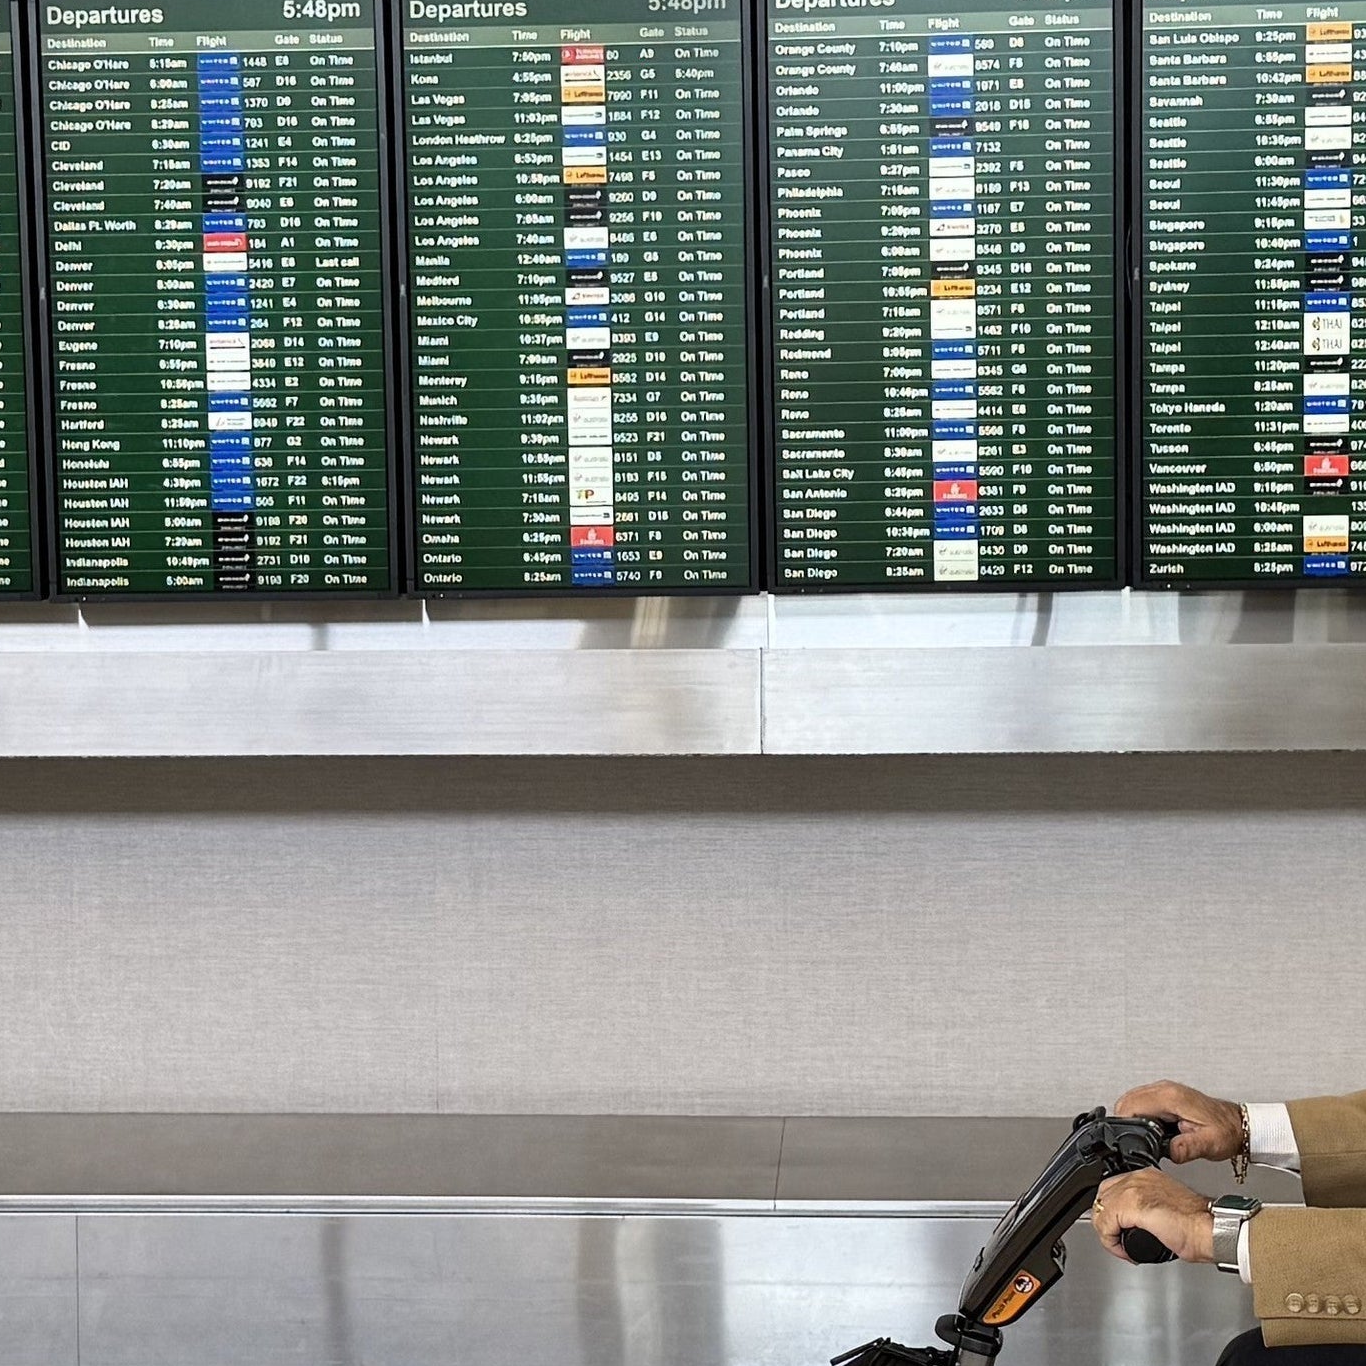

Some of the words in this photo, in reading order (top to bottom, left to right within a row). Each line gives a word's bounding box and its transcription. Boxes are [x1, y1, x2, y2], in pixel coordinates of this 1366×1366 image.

[46, 6, 163, 28] Departures
[283, 0, 360, 21] 5:48pm
[409, 0, 527, 22] Departures
[1149, 11, 1211, 22] Destination
[1256, 8, 1282, 19] Time
[1306, 7, 1338, 19] Flight
[775, 21, 835, 32] Destination
[879, 19, 905, 30] Time
[928, 17, 959, 30] Flight
[1008, 15, 1034, 26] Gate
[1044, 14, 1079, 25] Status
[47, 37, 106, 48] Destination
[148, 37, 173, 46] Time
[196, 36, 226, 47] Flight
[274, 34, 299, 44] Gate
[309, 34, 342, 43] Status
[409, 31, 469, 42] Destination
[511, 30, 537, 40] Time
[560, 29, 590, 41] Flight
[639, 27, 664, 37] Gate
[674, 26, 708, 36] Status
[410, 53, 452, 64] Istanbul
[411, 94, 430, 104] Las
[432, 94, 464, 106] Vegas
[51, 140, 70, 151] CID
[777, 147, 820, 157] Panama
[821, 145, 843, 158] City
[54, 241, 81, 251] Delhi
[280, 237, 294, 247] A1
